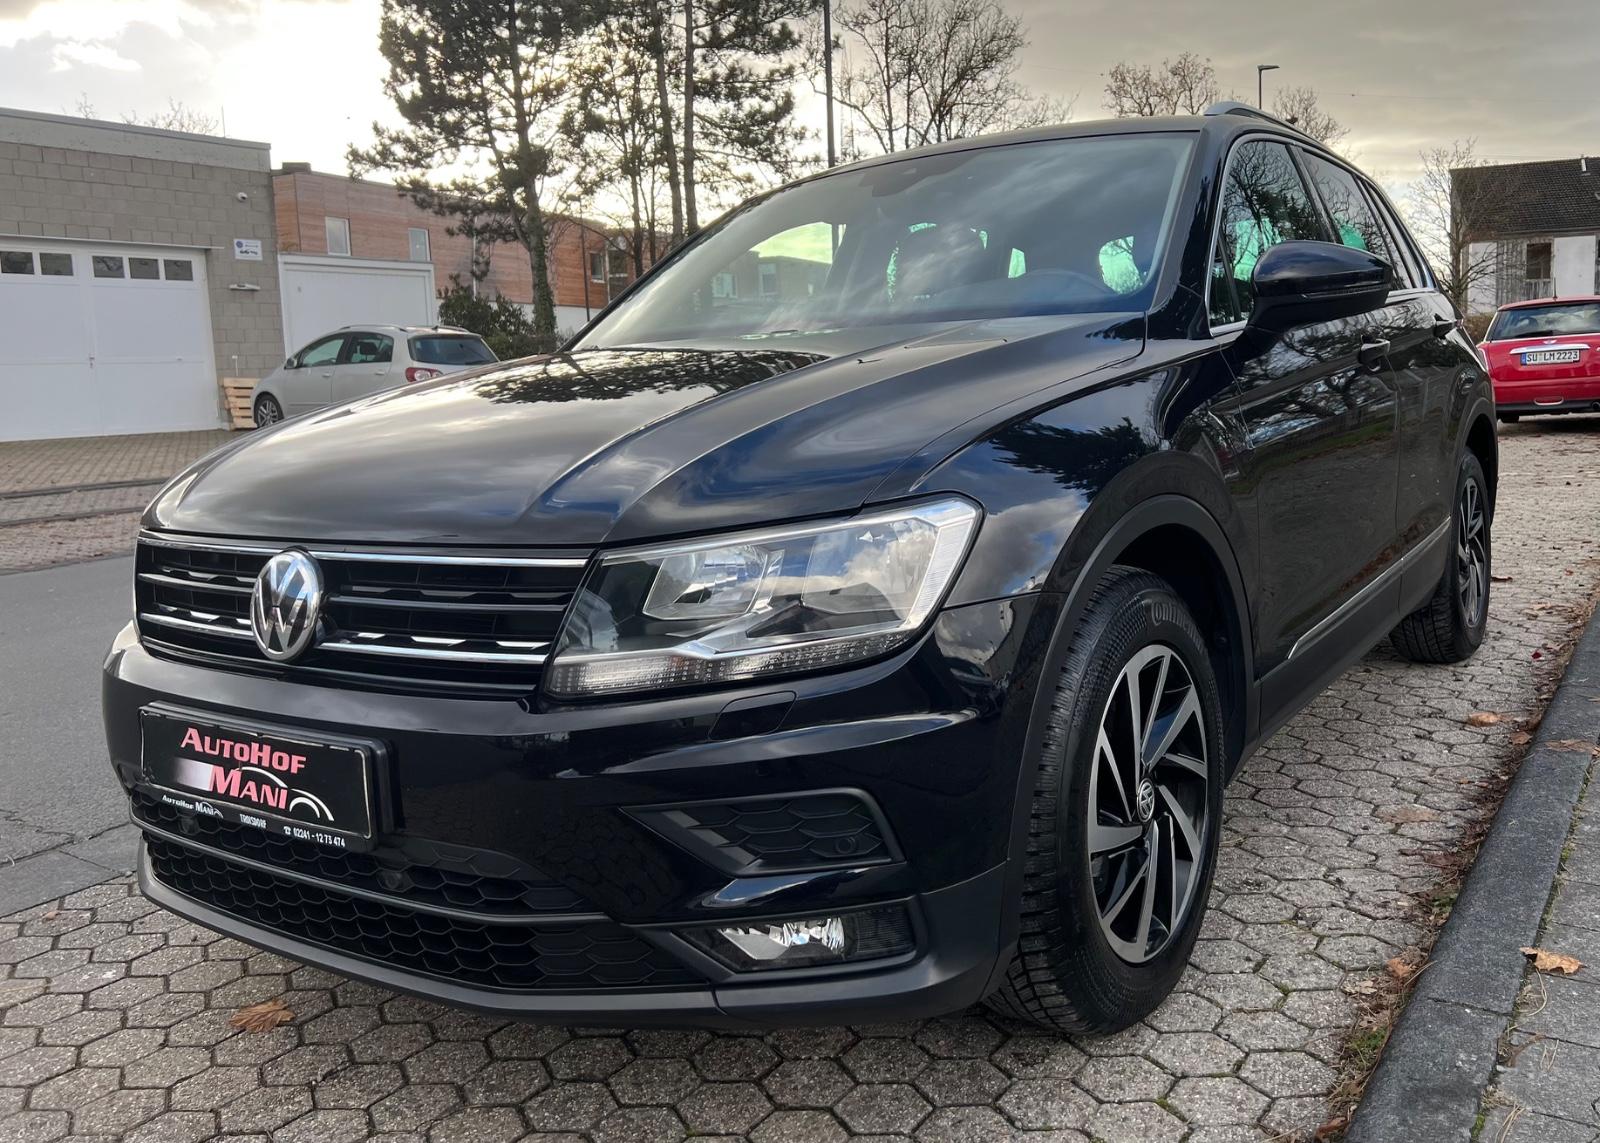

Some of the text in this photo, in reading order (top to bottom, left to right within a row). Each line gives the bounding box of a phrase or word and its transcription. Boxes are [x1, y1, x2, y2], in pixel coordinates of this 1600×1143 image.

[1527, 351, 1578, 362] SU LM 2223
[209, 765, 289, 810] MANI
[293, 827, 311, 840] 02241
